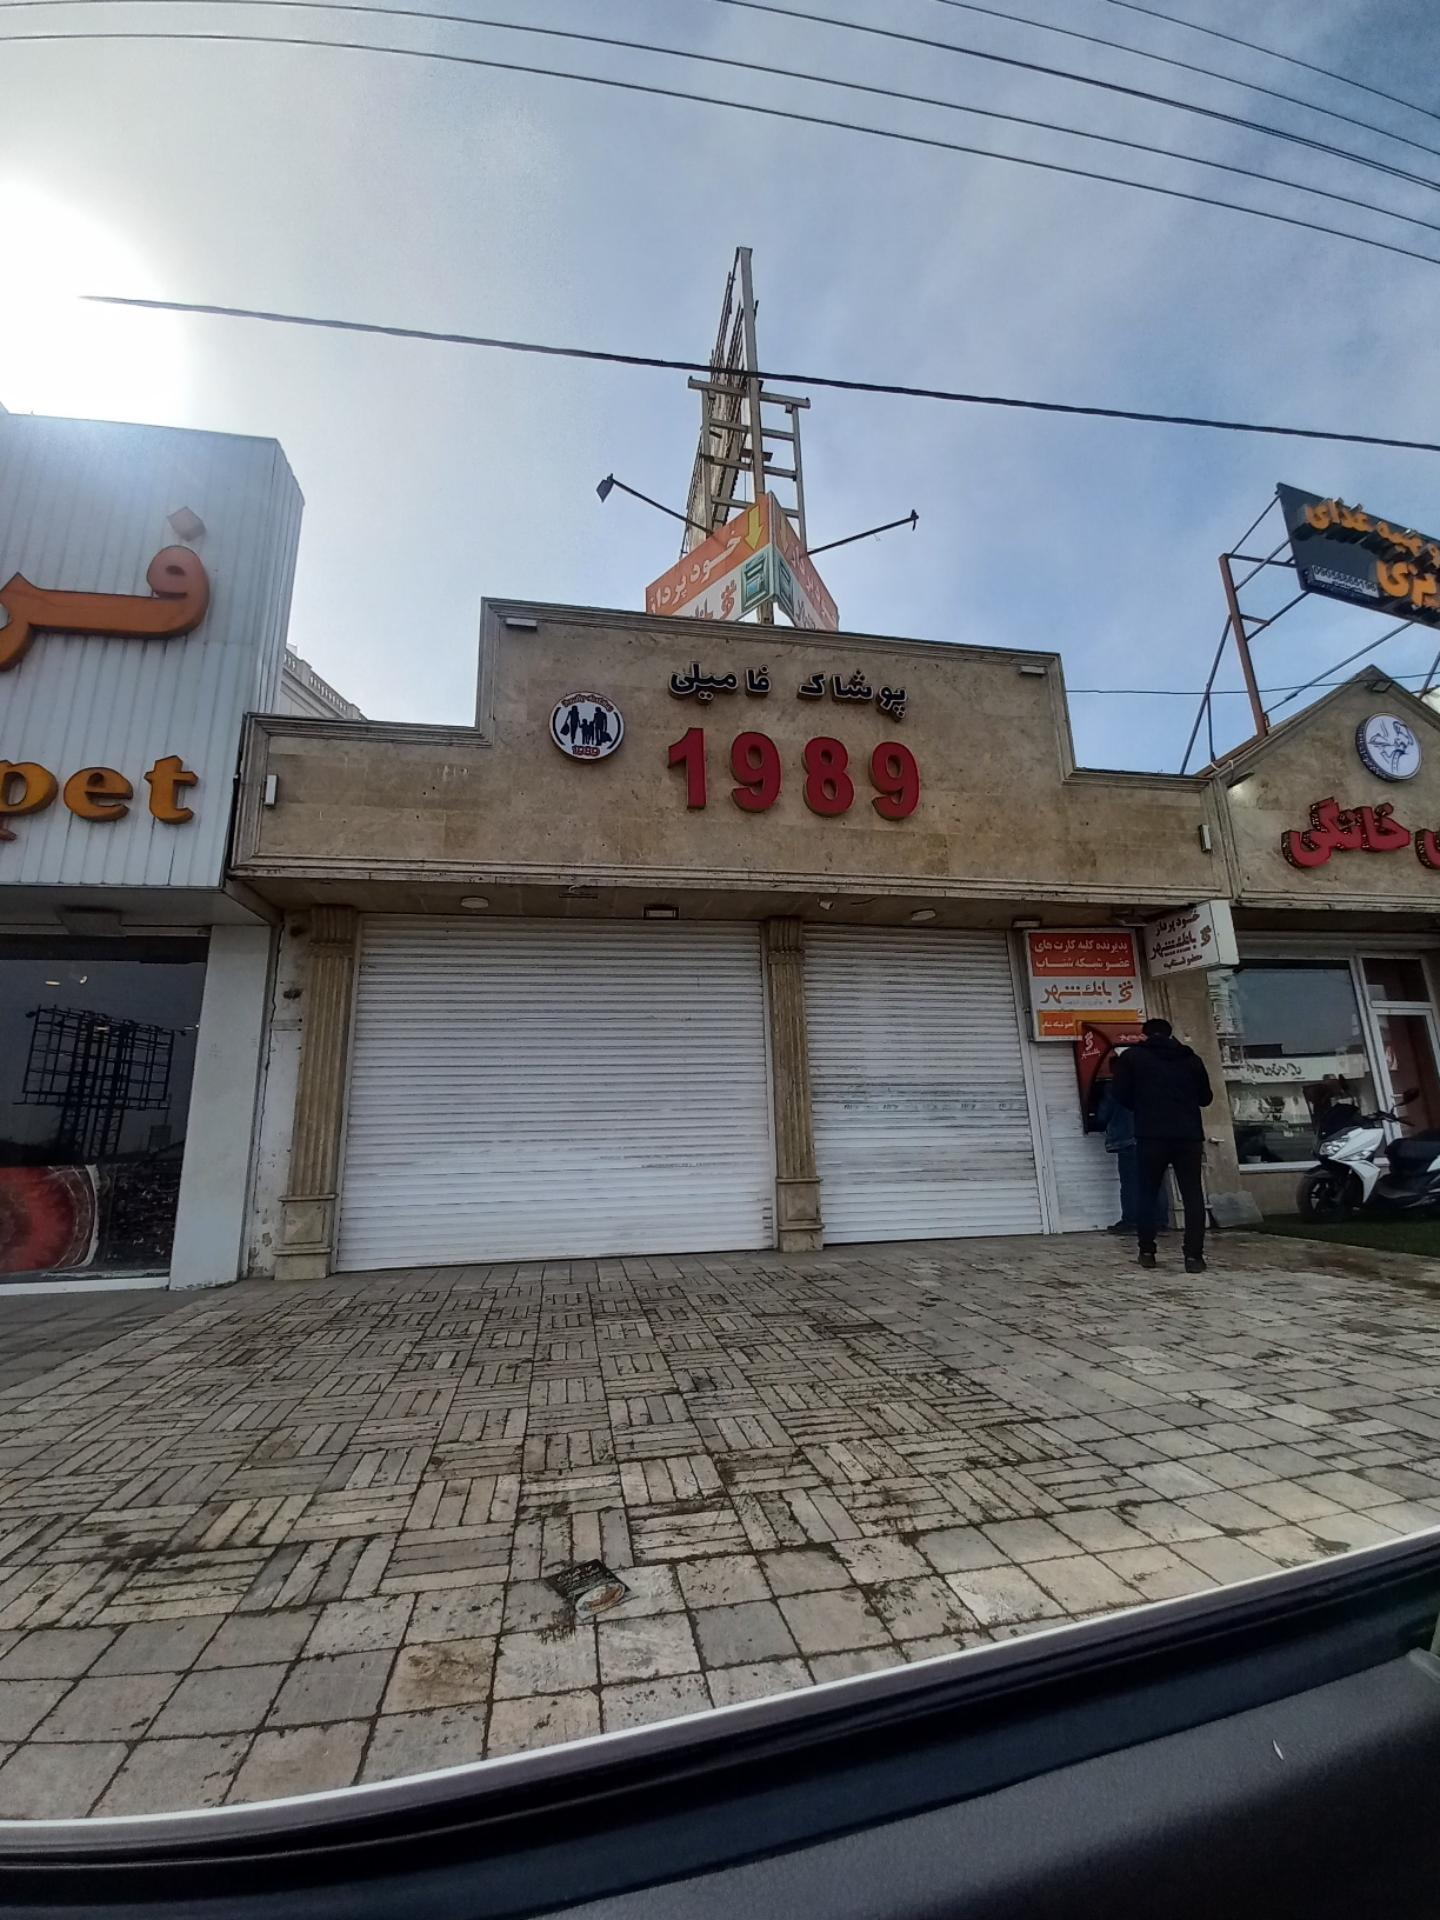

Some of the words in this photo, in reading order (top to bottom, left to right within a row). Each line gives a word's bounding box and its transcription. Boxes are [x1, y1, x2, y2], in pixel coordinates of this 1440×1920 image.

[669, 661, 773, 703] فامیلی
[798, 669, 908, 719] پوشاک
[667, 726, 921, 820] 1989
[1281, 796, 1412, 869] خانگی
[1078, 939, 1094, 952] کلیه
[1035, 957, 1075, 971] شتاب
[1075, 957, 1106, 970] شبکه
[1105, 958, 1131, 971] عضو
[1040, 984, 1082, 1005] شهر
[1082, 981, 1113, 1004] بانک
